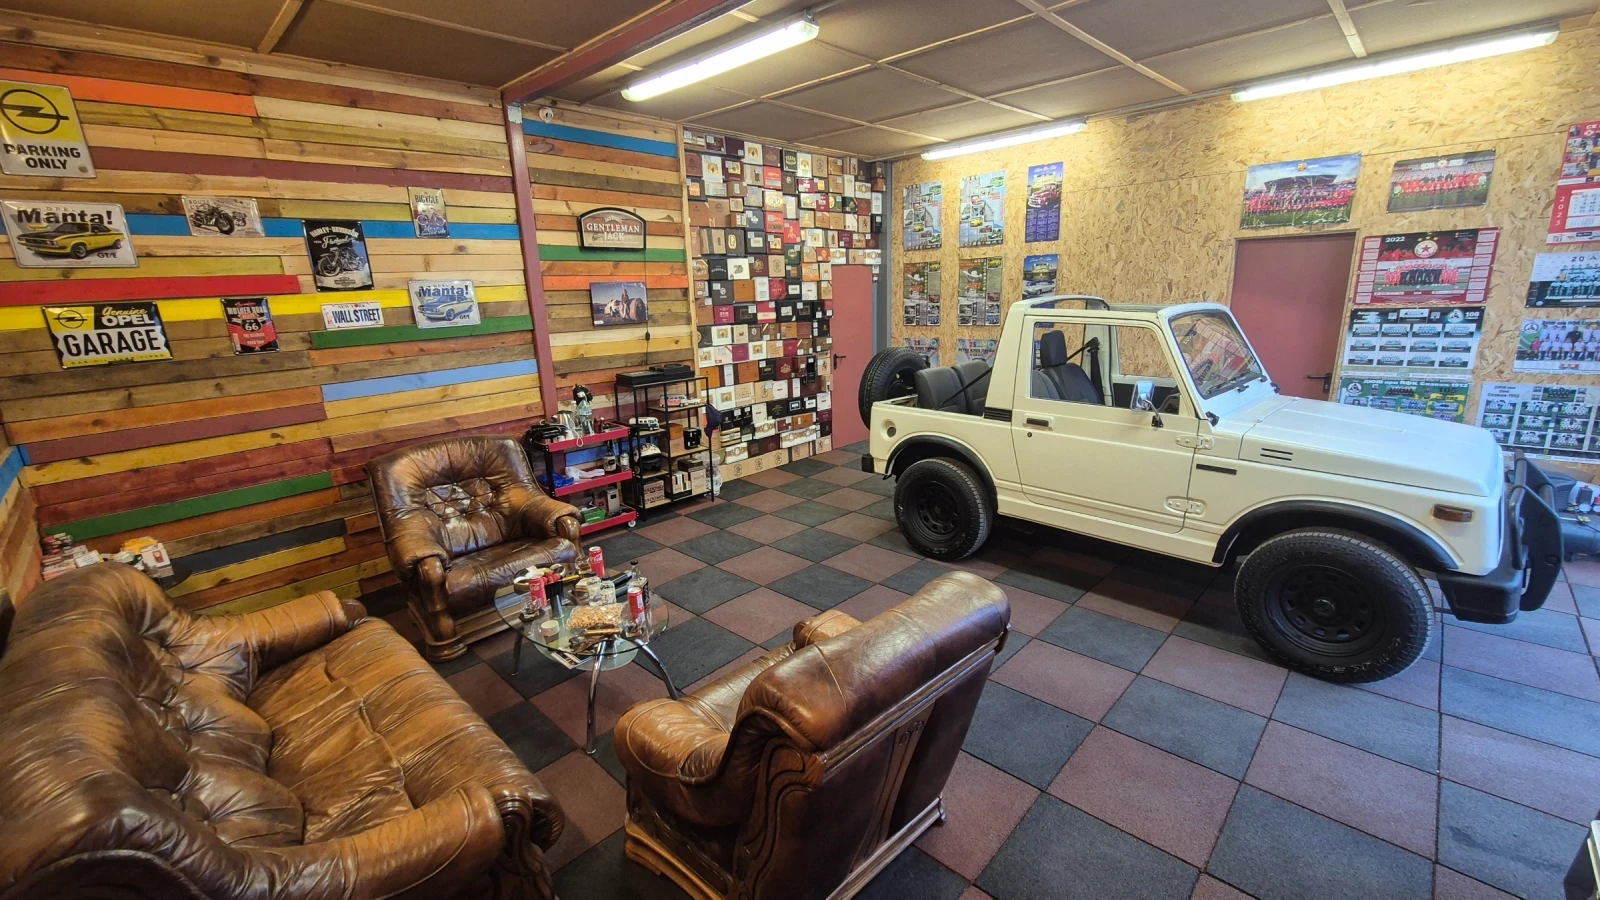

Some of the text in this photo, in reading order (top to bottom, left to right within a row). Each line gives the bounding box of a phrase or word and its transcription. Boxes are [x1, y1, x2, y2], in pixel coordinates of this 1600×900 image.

[3, 143, 81, 158] PARKING
[25, 157, 67, 170] ONLY
[414, 194, 439, 204] BICYCLE
[17, 208, 113, 225] Manta!
[586, 222, 640, 233] GENTLEMAN
[604, 232, 625, 241] JACK
[418, 285, 469, 298] Manta!
[101, 314, 155, 327] OPEL
[331, 309, 354, 324] WALL
[353, 308, 381, 322] STREET
[245, 323, 259, 331] 66
[63, 329, 161, 357] GARAGE
